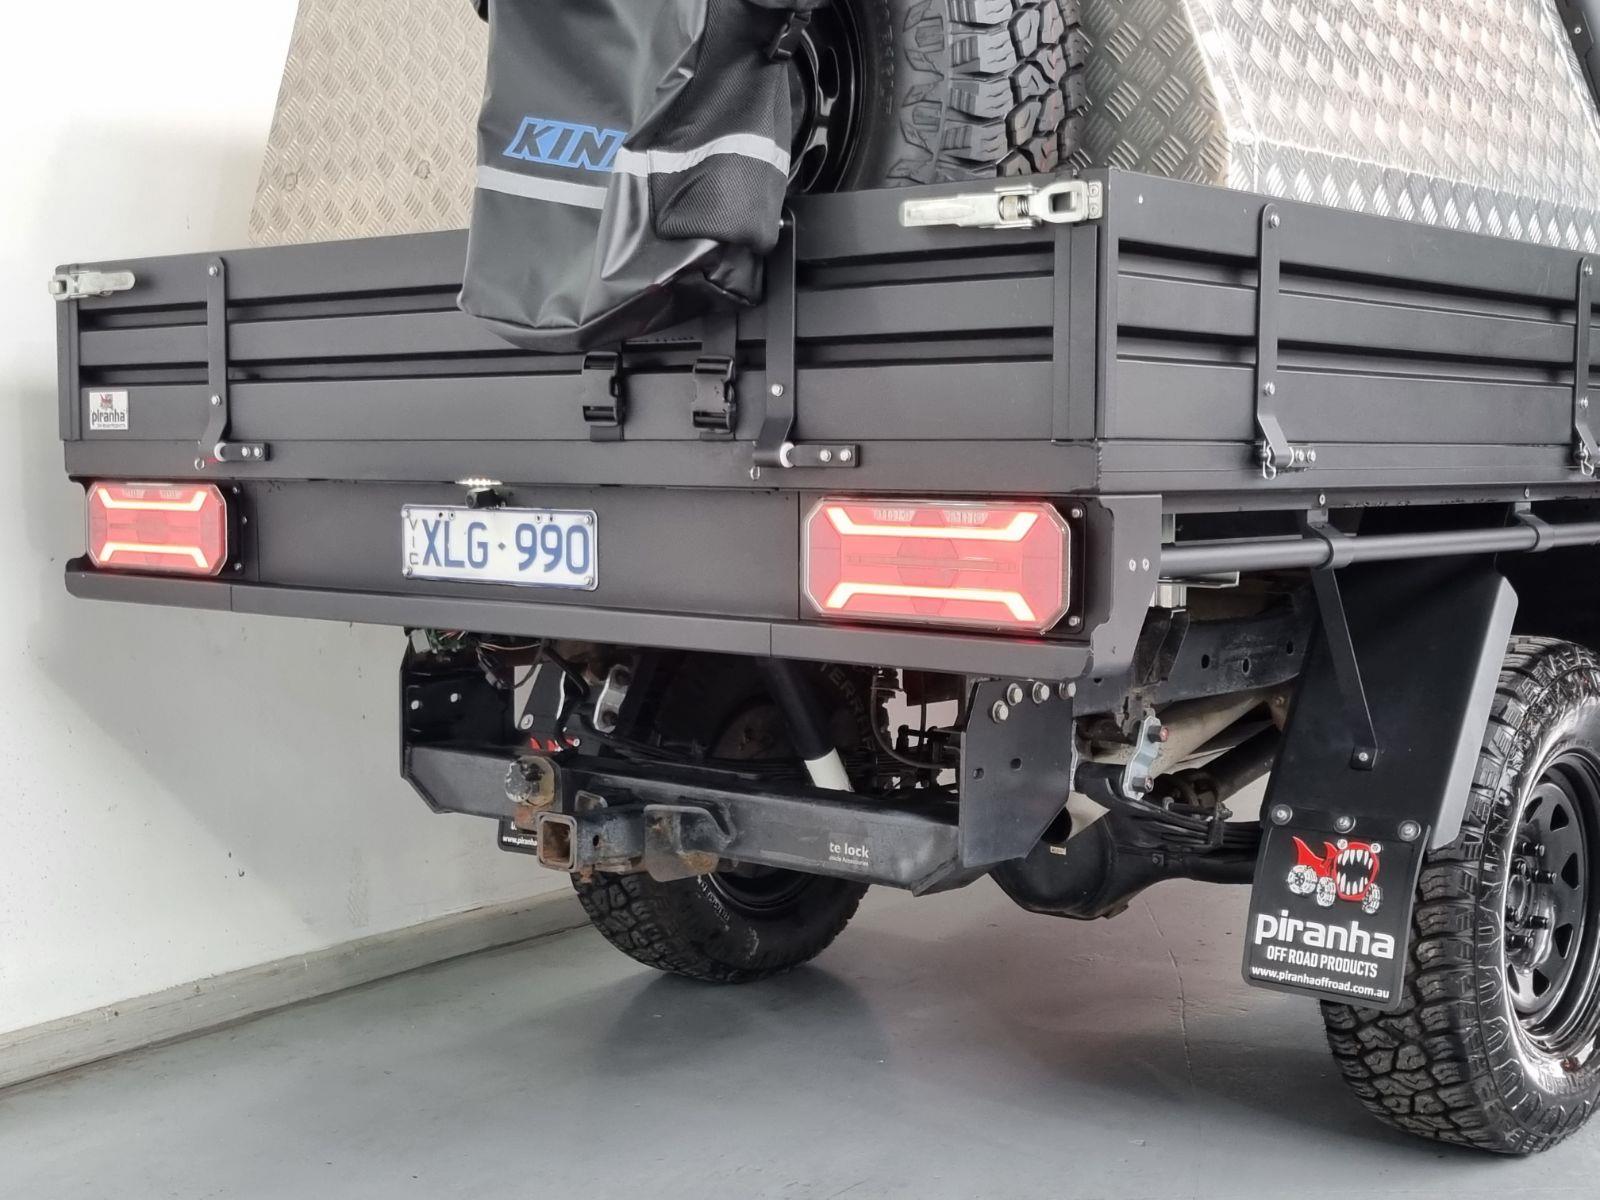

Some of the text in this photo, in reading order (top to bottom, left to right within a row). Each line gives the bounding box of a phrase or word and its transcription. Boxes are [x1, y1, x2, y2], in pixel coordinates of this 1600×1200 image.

[503, 116, 628, 172] KIN
[91, 408, 126, 426] piranha
[421, 518, 590, 575] XLG 990
[844, 842, 869, 858] lock
[1254, 909, 1396, 960] piranha
[1266, 945, 1379, 979] OFF ROAD PRODUCTS
[1251, 965, 1391, 999] www.piranhaoffroad.com.au
